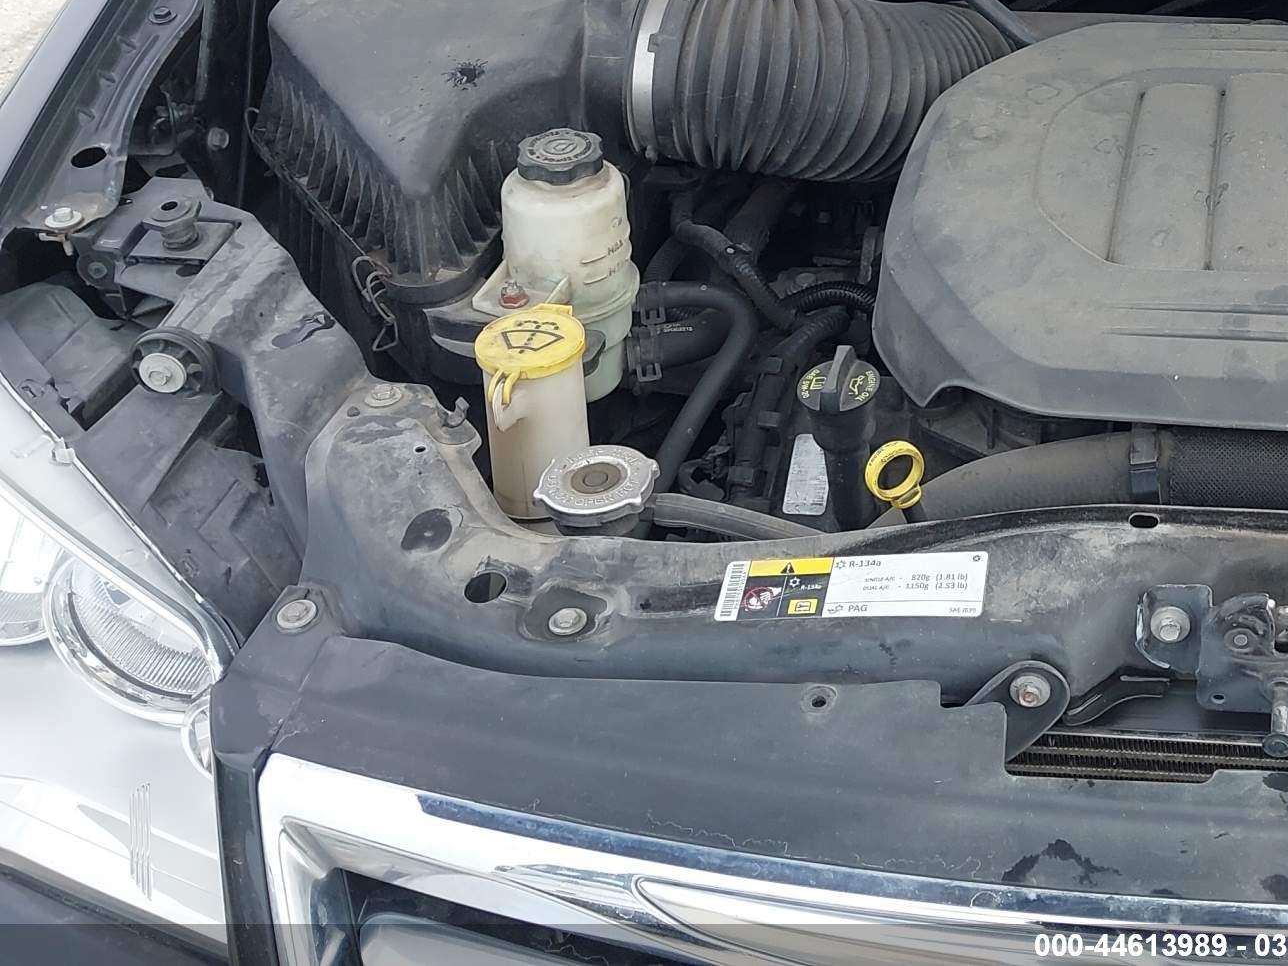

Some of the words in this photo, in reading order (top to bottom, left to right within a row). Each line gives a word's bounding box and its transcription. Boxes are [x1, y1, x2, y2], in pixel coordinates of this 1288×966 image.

[864, 370, 876, 392] ENGINE
[855, 391, 870, 402] OIL
[575, 493, 615, 507] OPEN
[848, 559, 882, 568] R-134a
[911, 574, 931, 582] 820g
[935, 573, 956, 582] (1.81
[957, 572, 968, 582] lb)
[905, 582, 930, 591] 1150g
[935, 582, 956, 591] (2.53
[957, 581, 969, 591] lb)
[848, 604, 869, 613] PAG
